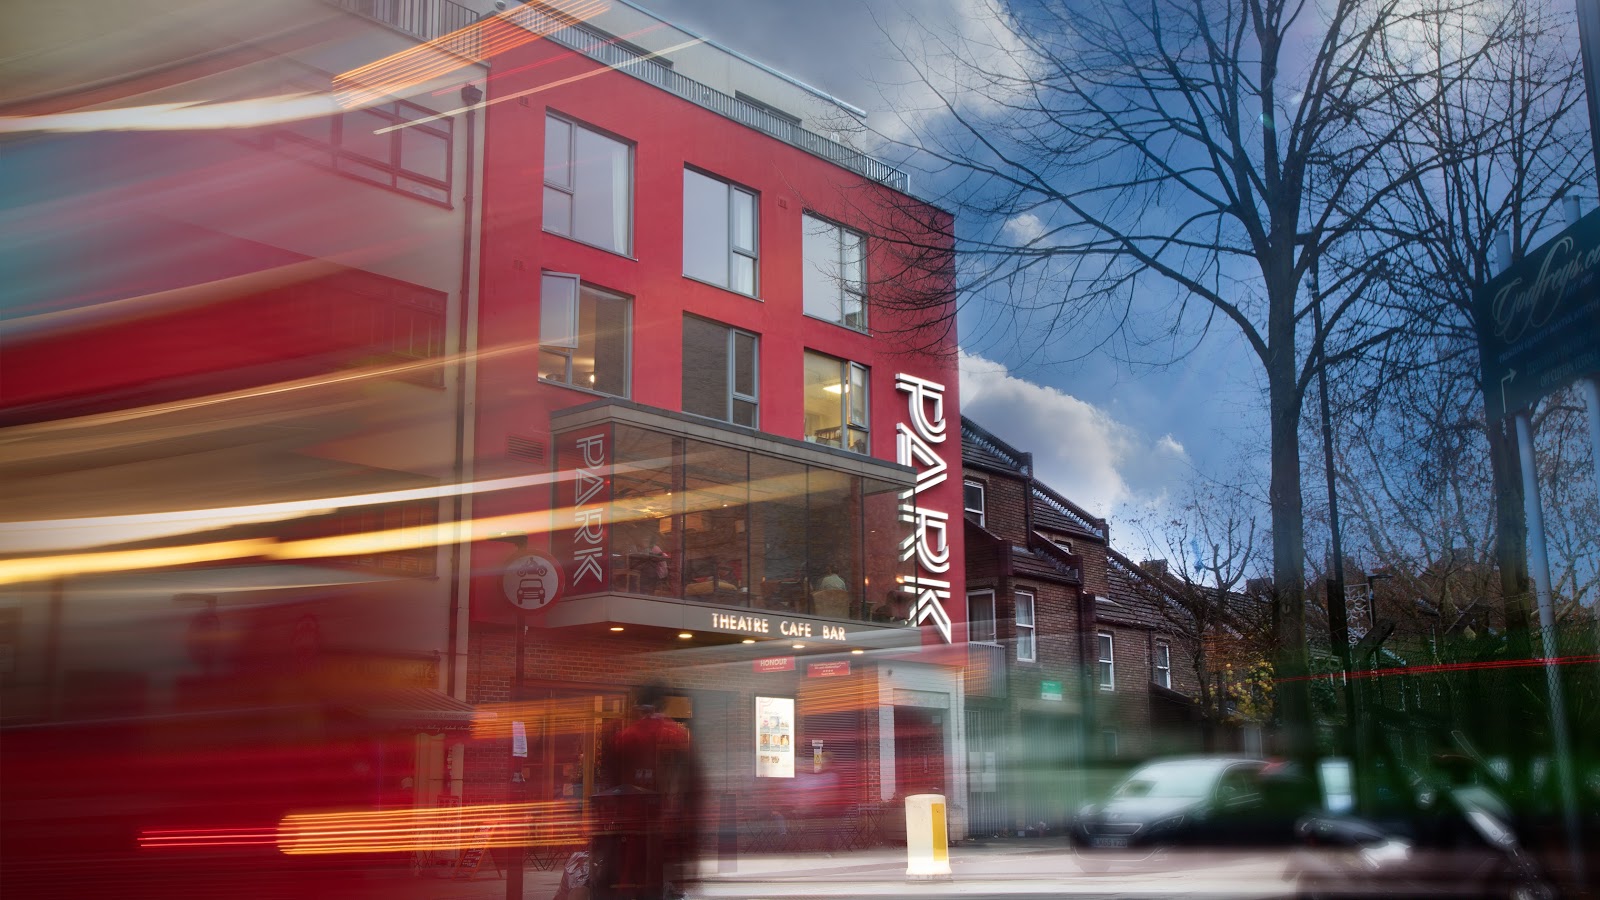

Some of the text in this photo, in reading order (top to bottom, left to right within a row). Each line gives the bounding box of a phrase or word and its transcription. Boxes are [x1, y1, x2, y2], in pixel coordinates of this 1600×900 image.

[573, 433, 604, 587] PARK
[895, 372, 952, 644] PARK
[712, 613, 846, 641] THEATRE CAFE BAR
[760, 658, 787, 667] HONOUR
